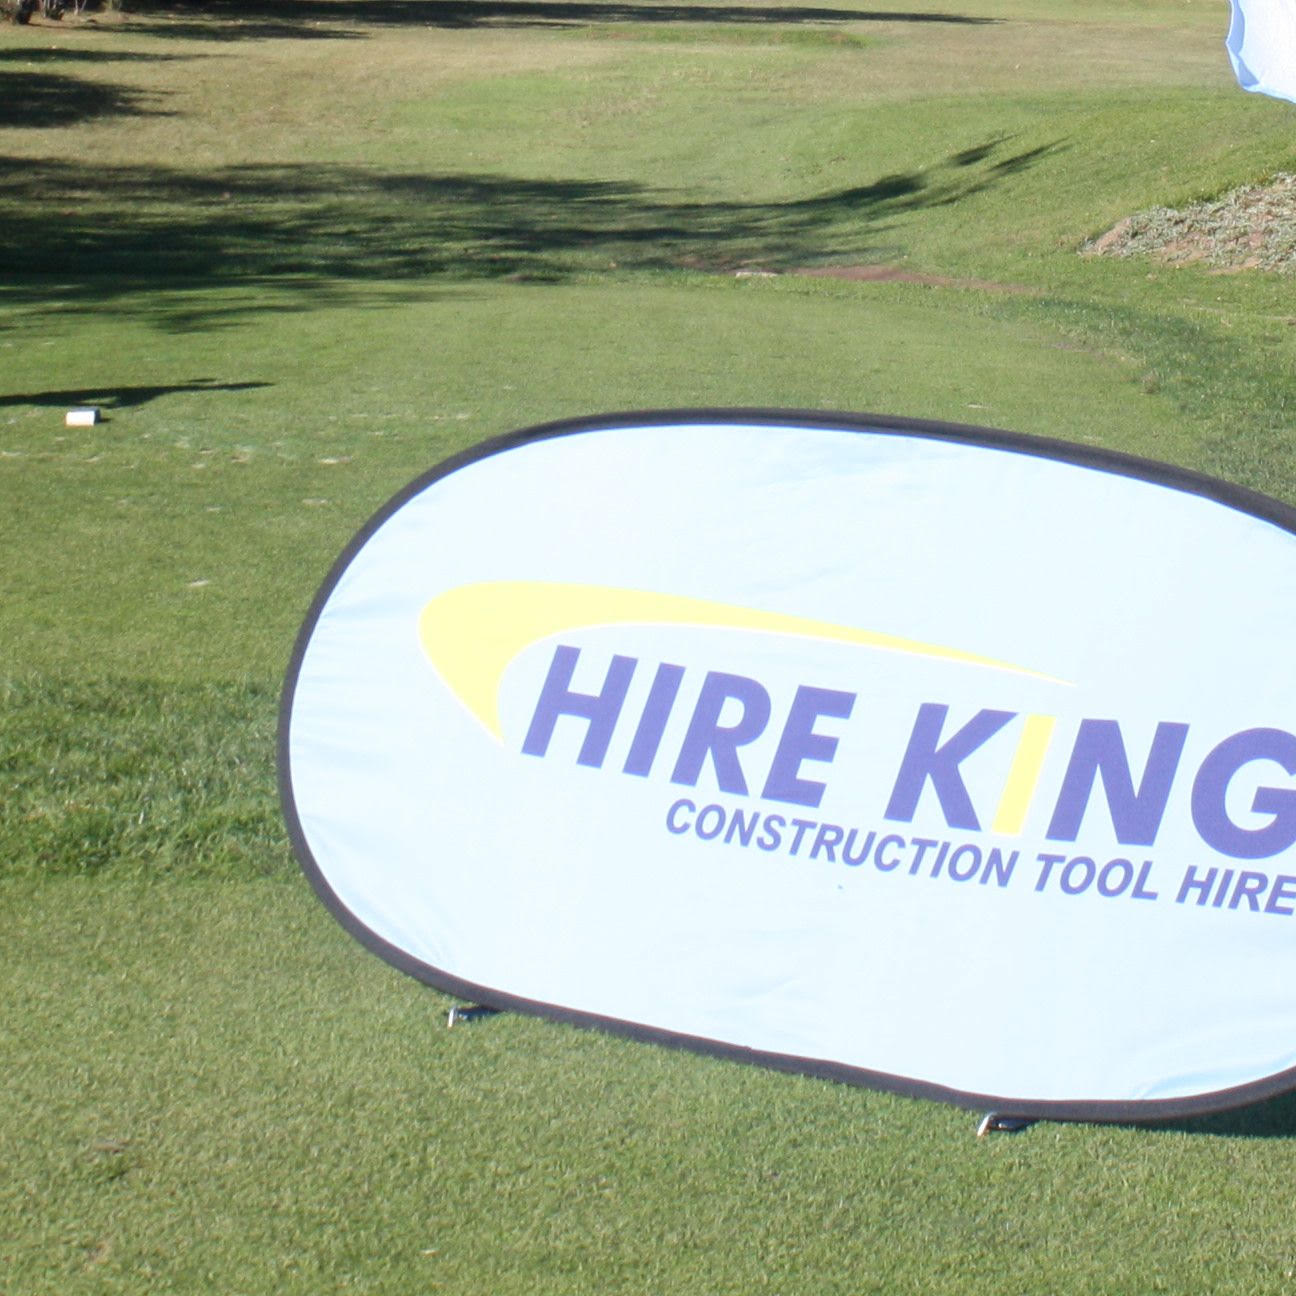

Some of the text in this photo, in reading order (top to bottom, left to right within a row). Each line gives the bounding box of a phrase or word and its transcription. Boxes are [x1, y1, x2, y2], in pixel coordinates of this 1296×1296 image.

[521, 644, 857, 809] HIRE
[665, 798, 1020, 888] CONSTRUCTION
[1034, 853, 1160, 901] TOOL
